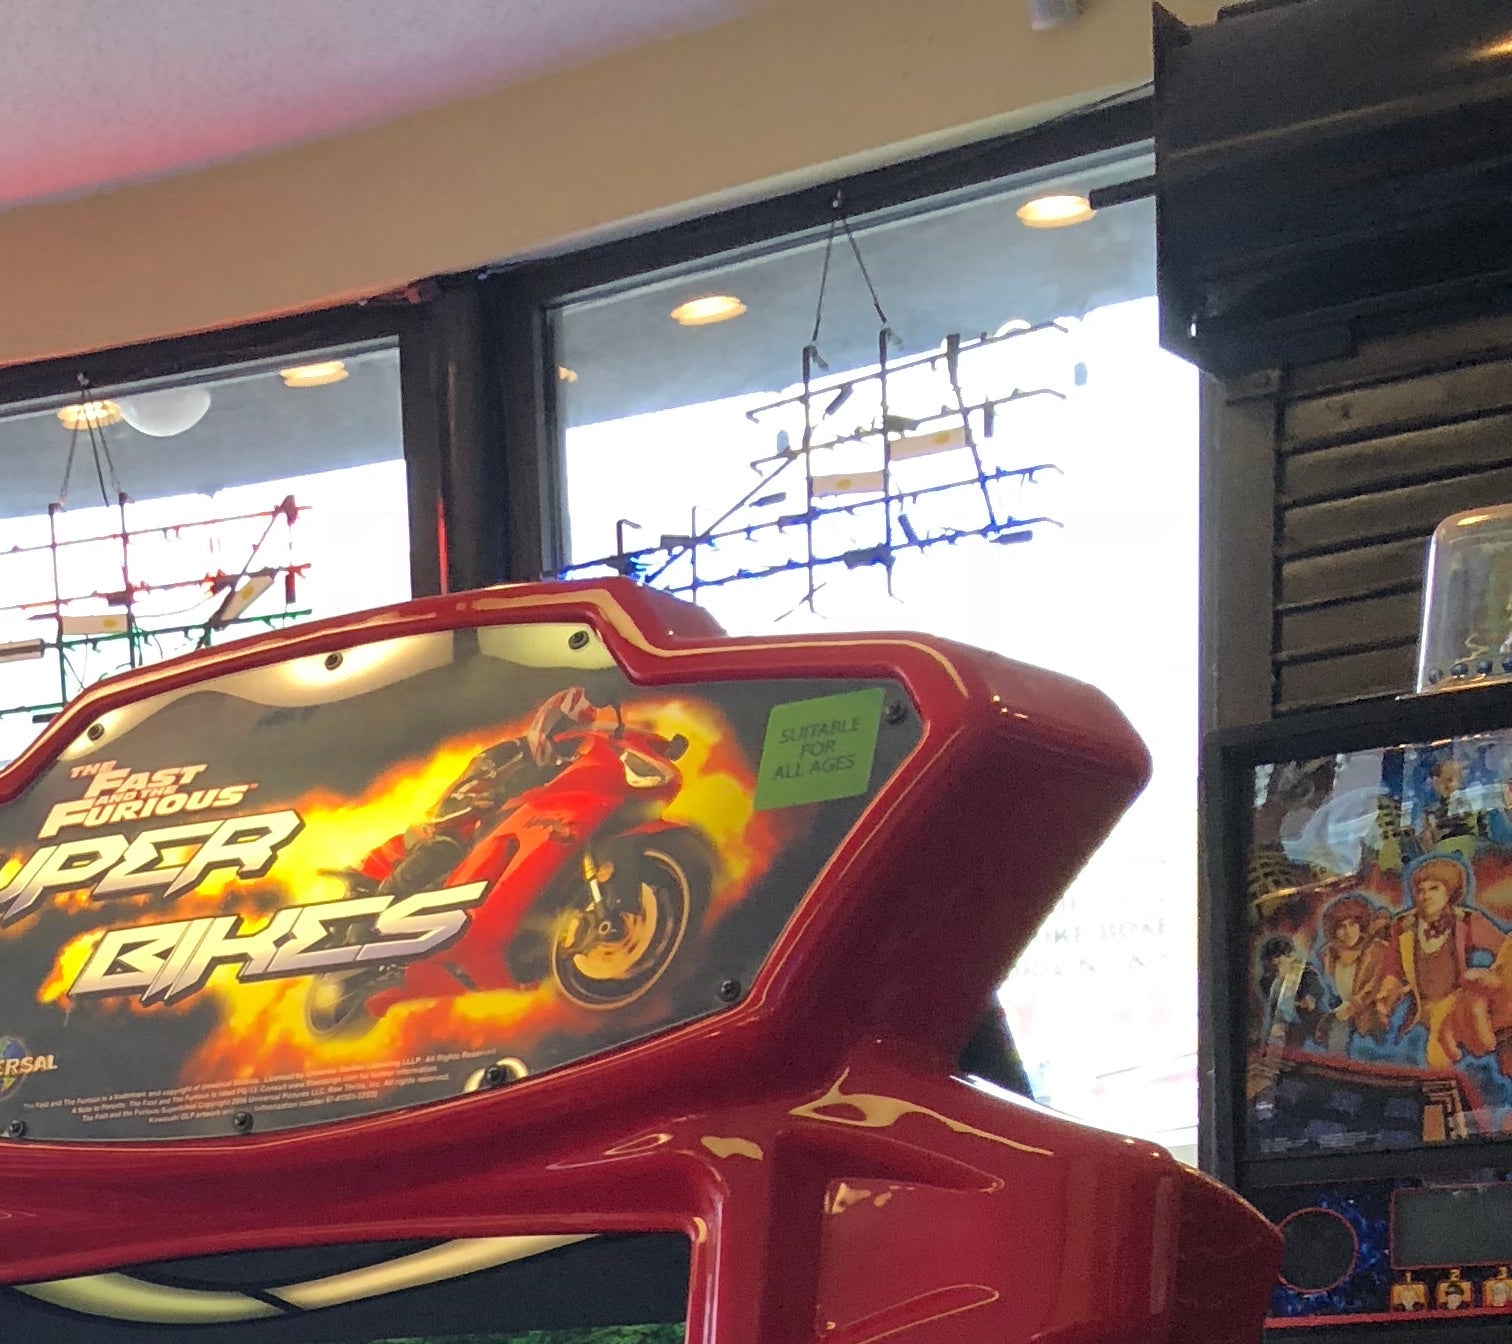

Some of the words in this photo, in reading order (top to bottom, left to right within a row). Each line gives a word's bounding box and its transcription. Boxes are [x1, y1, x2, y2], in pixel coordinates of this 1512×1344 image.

[779, 717, 862, 744] SUITABLE
[800, 740, 836, 757] FOR
[70, 760, 117, 779] THE
[772, 762, 803, 780] ALL
[809, 753, 856, 774] AGES
[84, 763, 208, 799] FAST
[95, 789, 139, 805] AND
[140, 784, 178, 799] THE
[37, 783, 249, 839] FURIOUS
[68, 880, 489, 1001] BIKES
